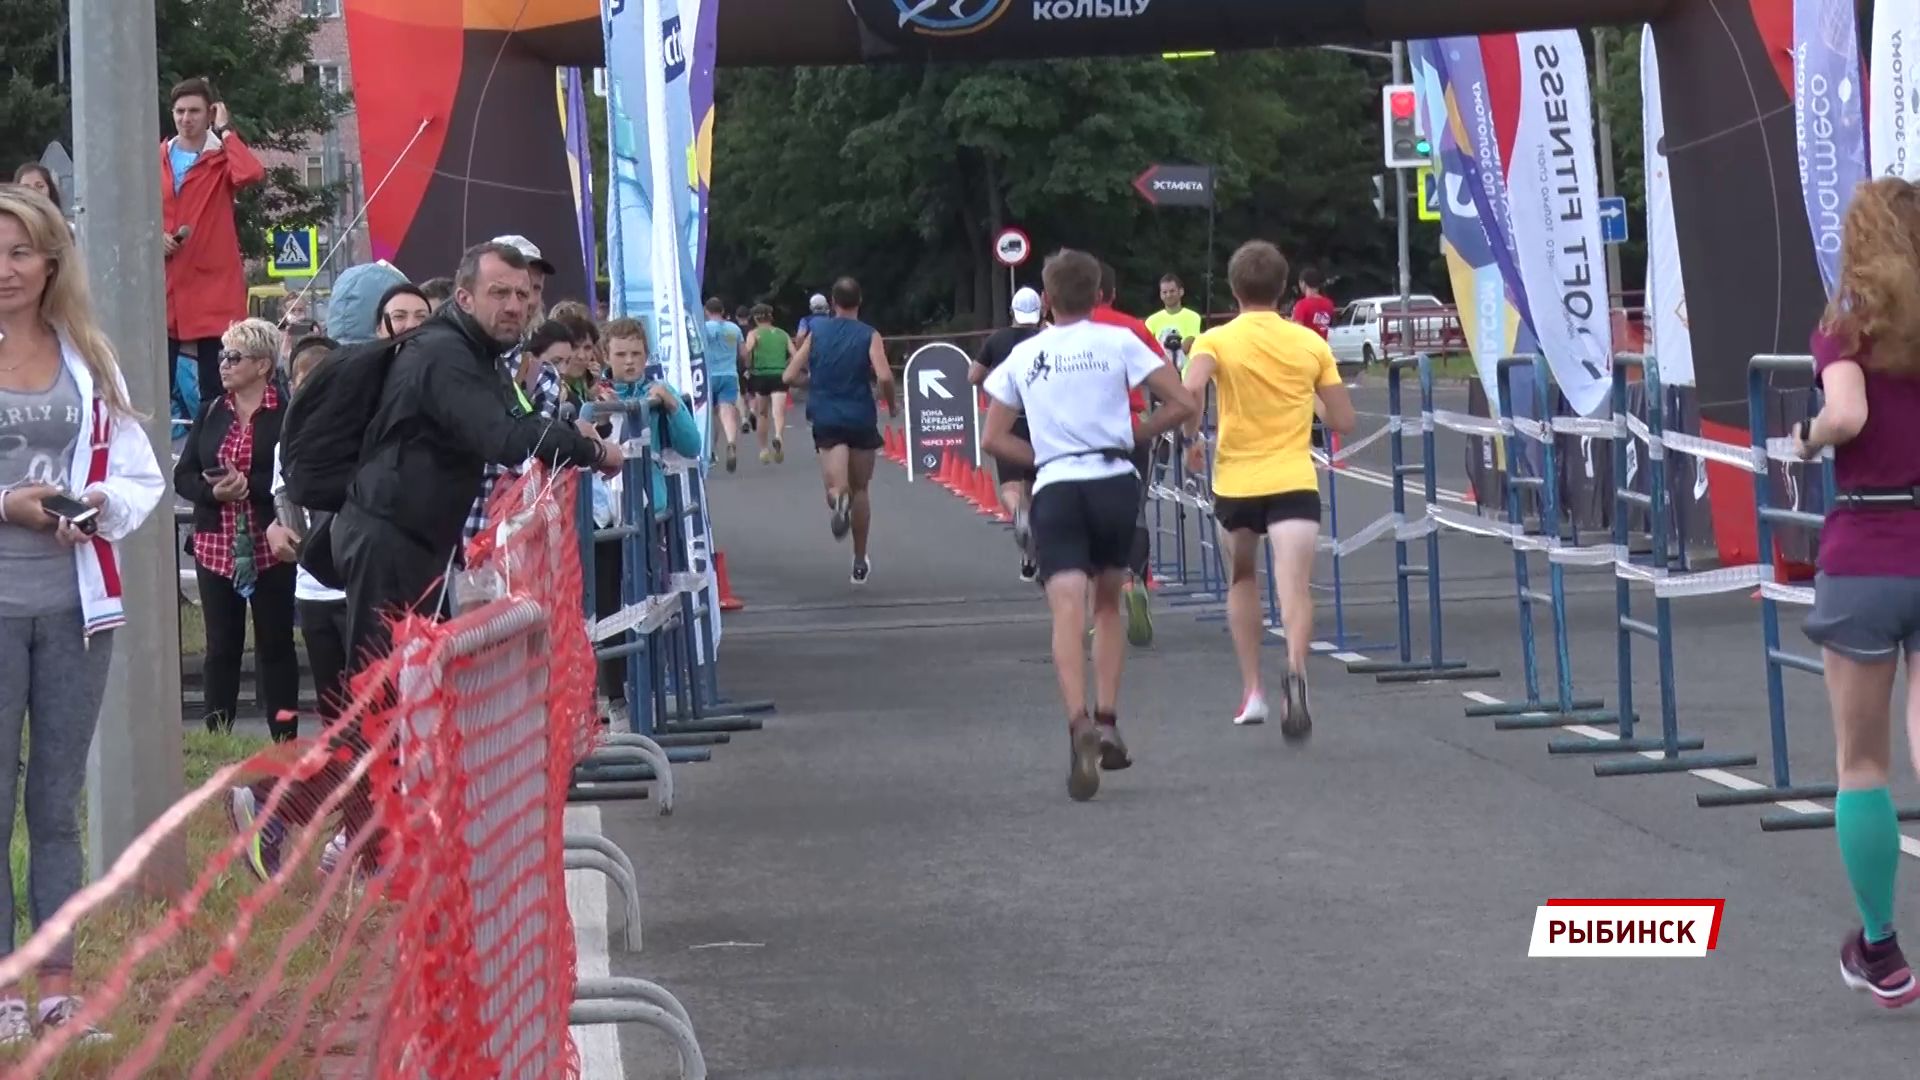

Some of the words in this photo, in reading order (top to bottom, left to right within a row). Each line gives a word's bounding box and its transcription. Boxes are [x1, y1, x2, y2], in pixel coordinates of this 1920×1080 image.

[1033, 0, 1150, 21] КОЛЬЦУ
[1152, 180, 1204, 191] ЭСТАФЕТА
[1055, 350, 1093, 363] Russia
[1055, 359, 1110, 374] Running
[920, 416, 964, 424] ПЕРЕДАЧИ
